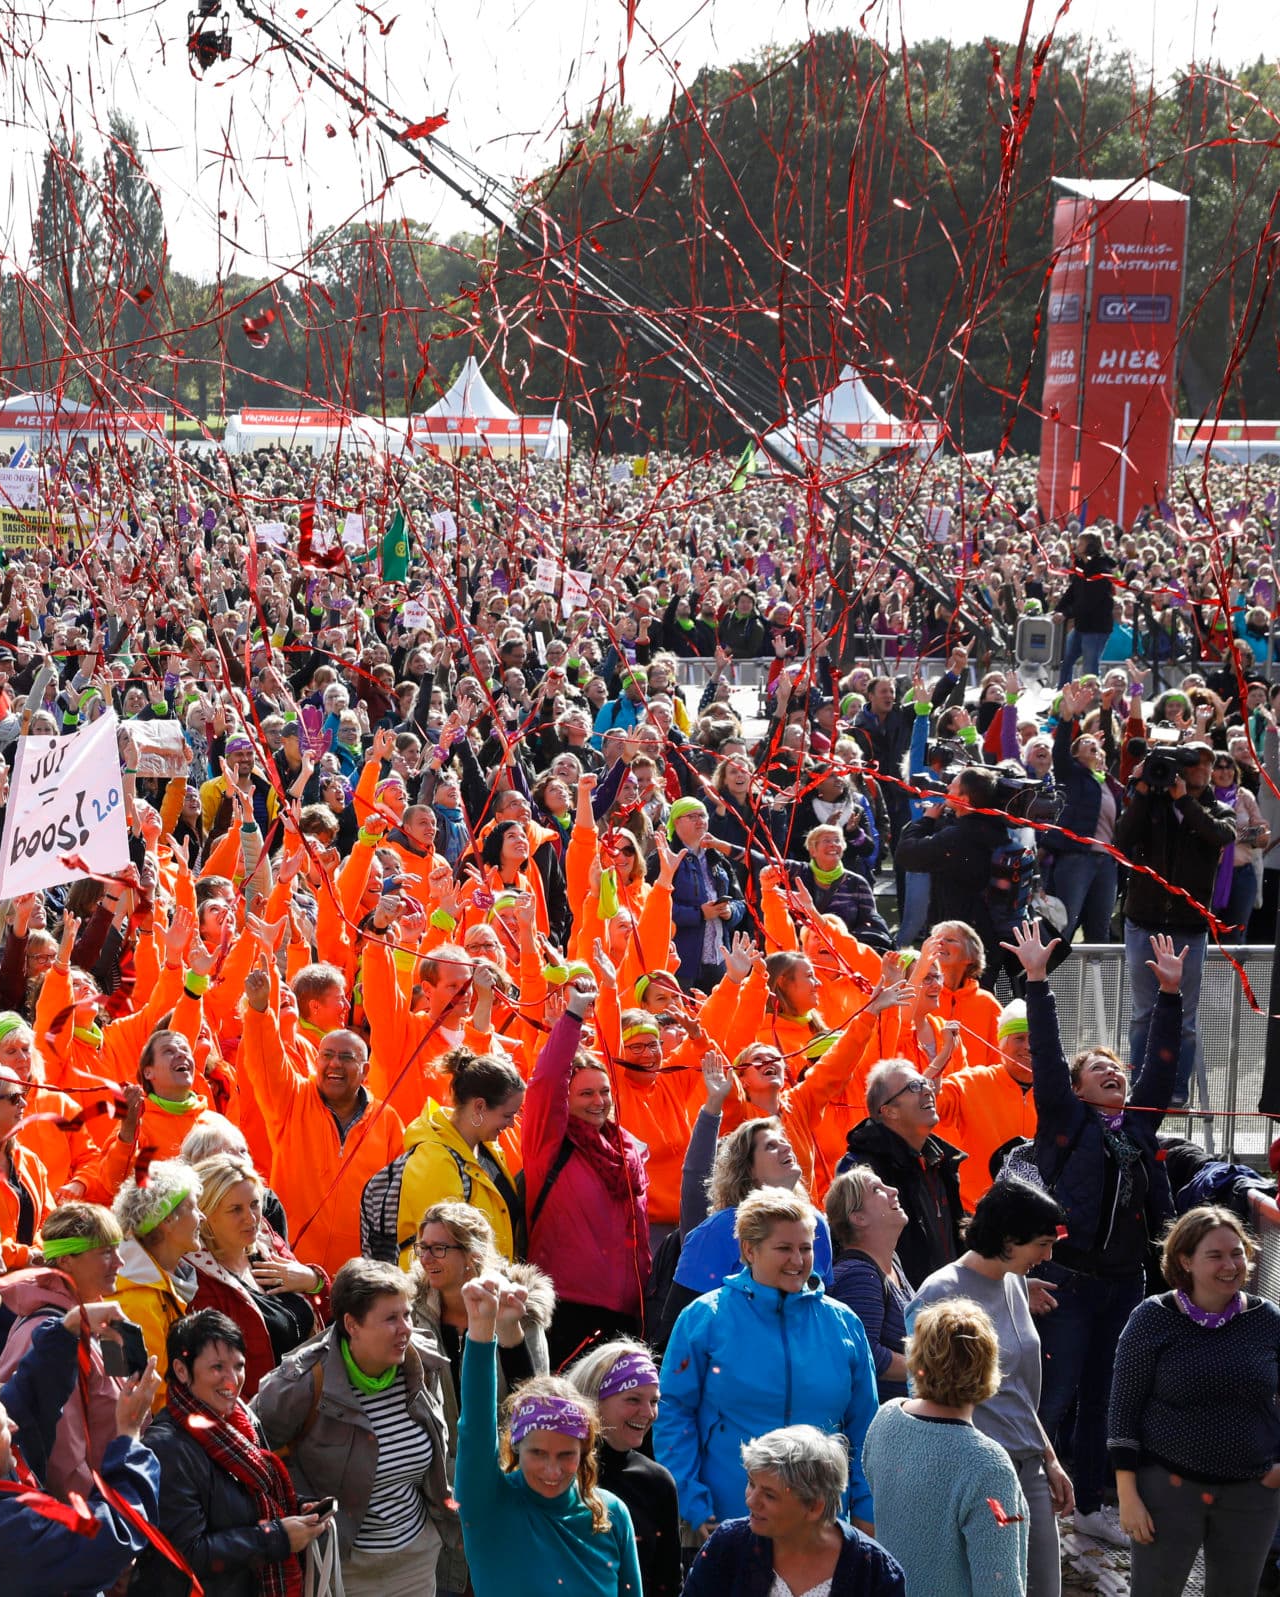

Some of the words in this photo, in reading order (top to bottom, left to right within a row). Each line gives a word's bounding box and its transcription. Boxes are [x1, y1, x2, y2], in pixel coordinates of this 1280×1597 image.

[1050, 350, 1075, 369] HIER
[1099, 350, 1162, 369] HIER
[1091, 374, 1167, 385] INLEVEREN
[15, 416, 55, 426] MEET
[10, 790, 89, 866] boos!
[92, 788, 119, 822] 2.0
